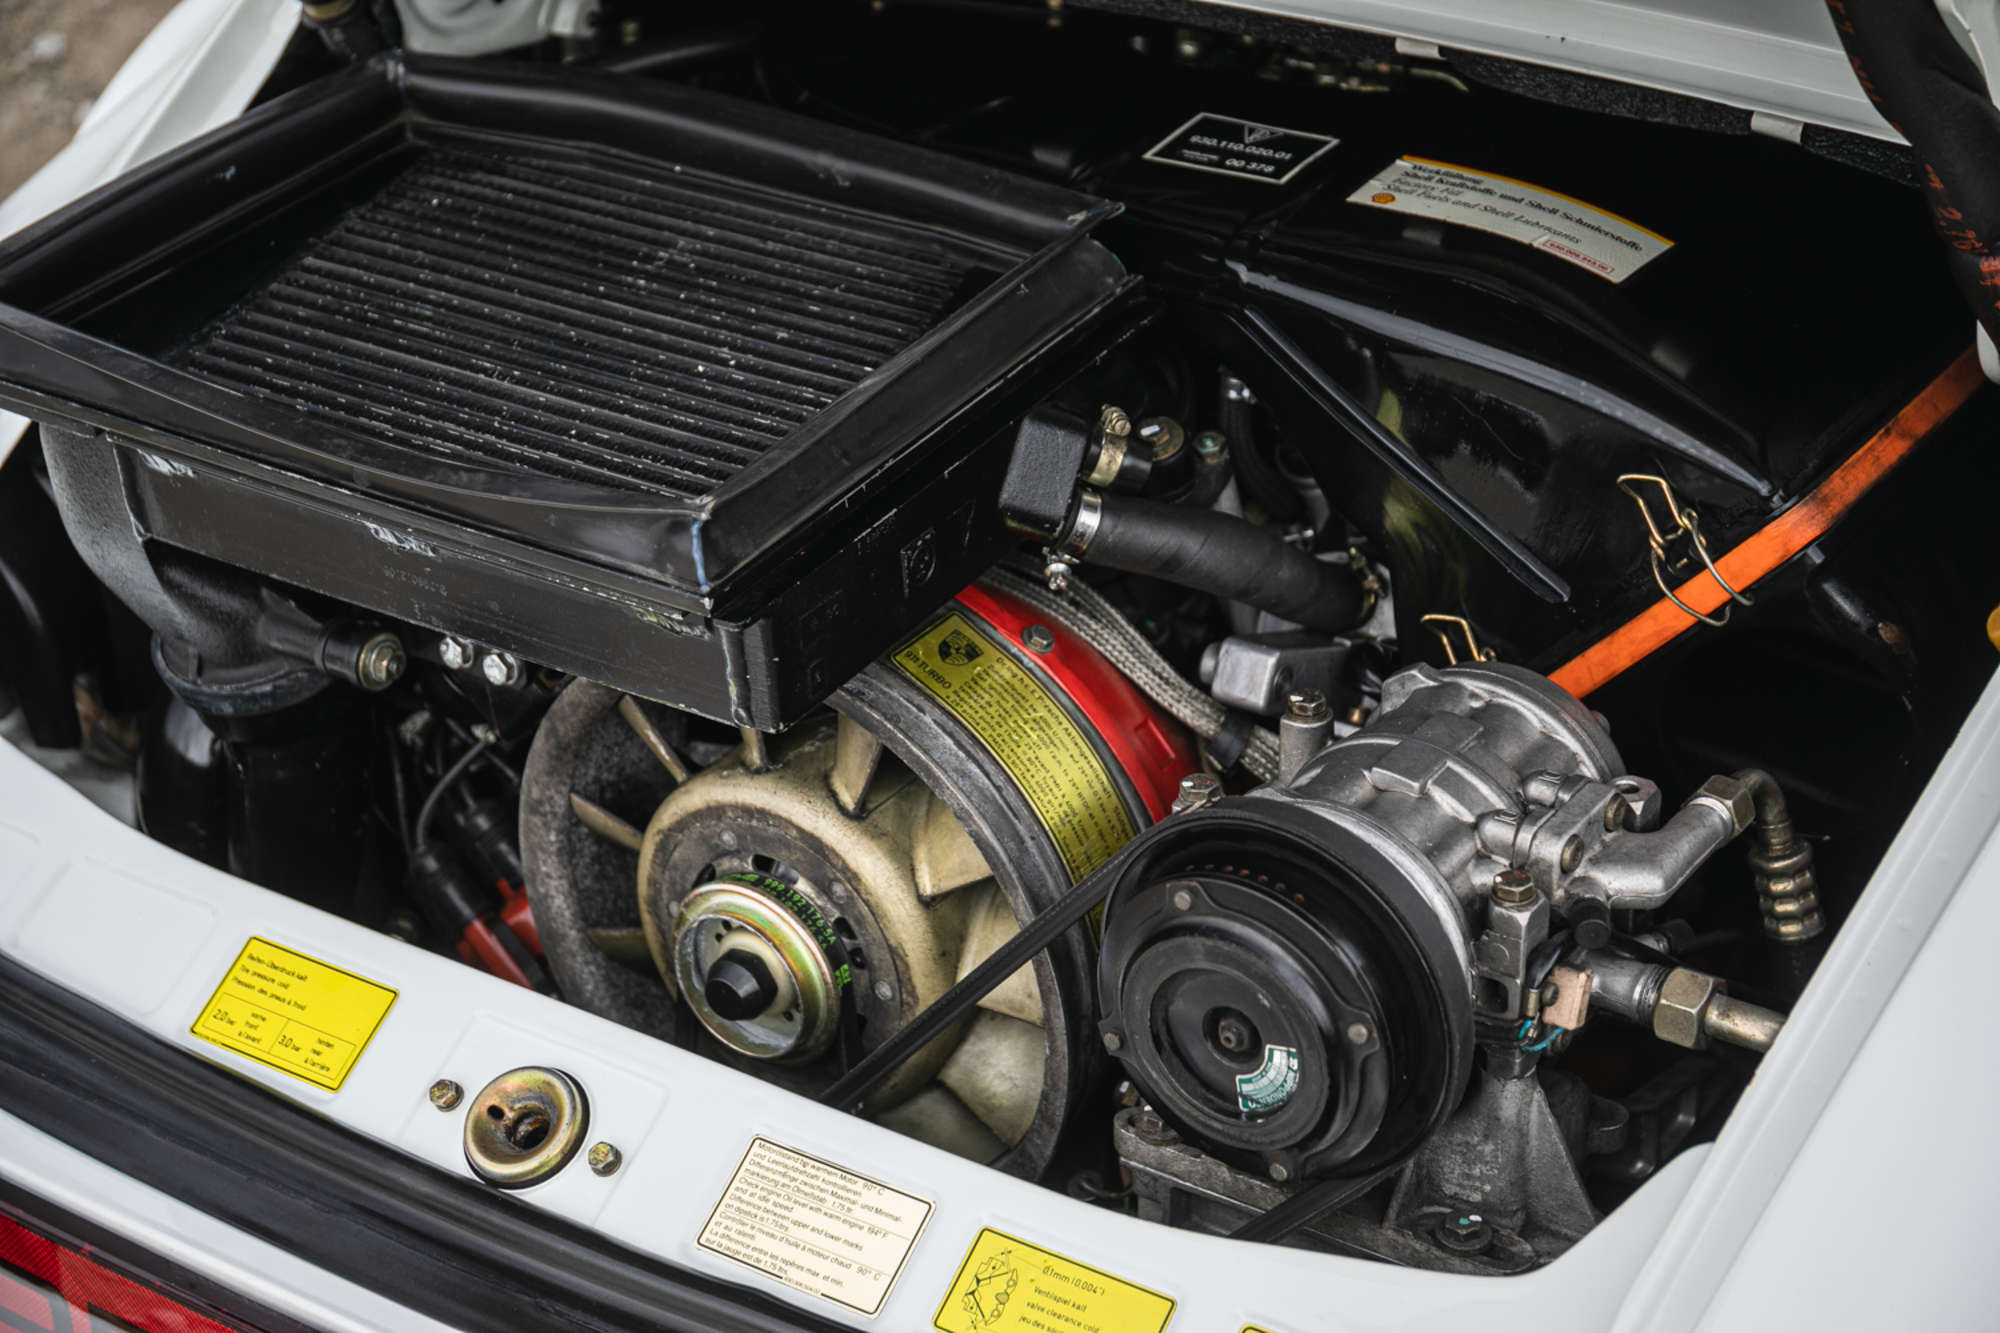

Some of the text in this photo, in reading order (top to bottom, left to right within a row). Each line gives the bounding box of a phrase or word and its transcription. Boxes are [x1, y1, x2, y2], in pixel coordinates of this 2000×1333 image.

[1190, 135, 1292, 160] 930.110.020.01
[1246, 162, 1275, 173] 378
[1383, 184, 1417, 195] Shell
[1451, 200, 1481, 209] and
[1478, 205, 1515, 218] Shell
[1513, 215, 1582, 244] Lubricants
[1401, 171, 1435, 182] Shell
[1499, 193, 1525, 203] und
[1525, 200, 1560, 215] Shell
[1560, 212, 1642, 251] Schmierstoffe
[904, 650, 952, 689] 911 TURBO
[251, 971, 276, 984] pressure
[277, 982, 290, 990] cold
[753, 1152, 767, 1161] und
[839, 1172, 858, 1185] Motor
[734, 1186, 748, 1195] and
[757, 1195, 770, 1203] idle
[772, 1200, 794, 1213] speed
[738, 1177, 759, 1189] Check
[759, 1186, 782, 1198] engine
[823, 1211, 842, 1221] warm
[841, 1218, 864, 1231] engine
[860, 1203, 875, 1212] und
[729, 1193, 762, 1211] Difference
[762, 1206, 790, 1221] between
[790, 1219, 810, 1229] upper
[810, 1226, 824, 1236] and
[824, 1231, 842, 1242] lower
[734, 1206, 758, 1219] dipstick
[751, 1246, 769, 1256] entre
[769, 1252, 779, 1261] les
[757, 1227, 778, 1240] niveau
[807, 1247, 830, 1260] moteur
[830, 1257, 852, 1270] chaud
[1026, 1302, 1045, 1312] valve
[1046, 1310, 1082, 1327] clearance
[1032, 1320, 1045, 1330] des
